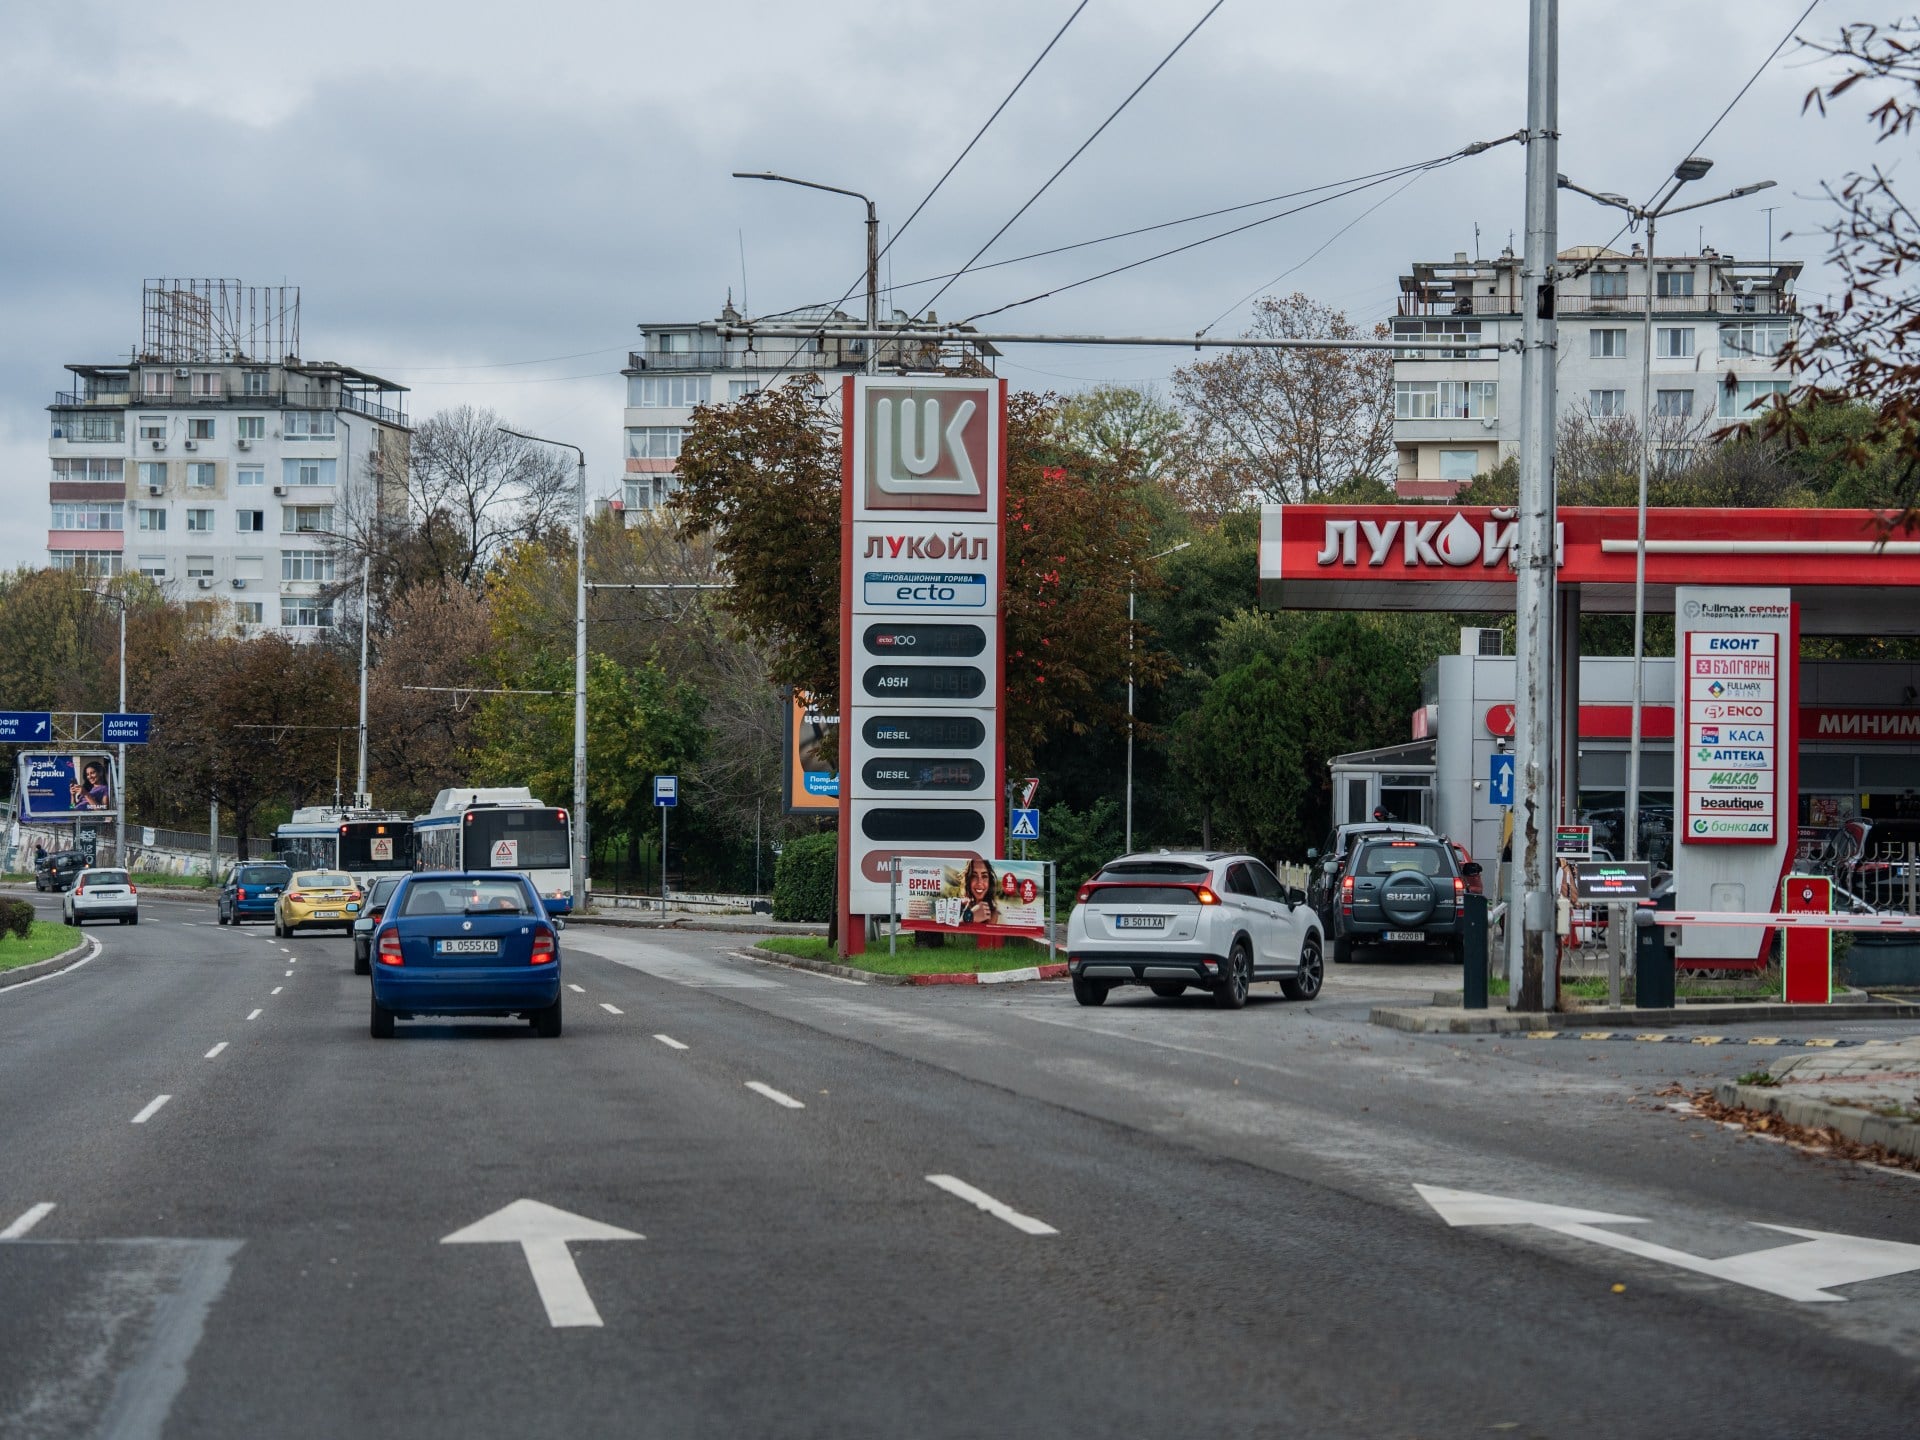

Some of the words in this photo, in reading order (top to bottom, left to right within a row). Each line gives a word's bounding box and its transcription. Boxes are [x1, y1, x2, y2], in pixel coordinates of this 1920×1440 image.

[1318, 507, 1564, 567] ЛУКОЙ
[864, 531, 988, 560] ЛУКОЙЛ
[882, 574, 941, 582] ИНОВАЦИОННИ
[944, 574, 973, 583] ГОРИВА
[896, 584, 955, 600] ecto
[1702, 604, 1746, 613] fullmax
[1750, 605, 1788, 614] center
[1710, 638, 1760, 650] ЕКОНТ
[878, 677, 908, 687] A95H
[1728, 706, 1762, 716] ENCO
[1729, 730, 1764, 741] КАСА
[1714, 750, 1764, 760] АПТЕКА
[1708, 772, 1759, 785] МАКАО
[1701, 797, 1764, 811] beautique
[909, 879, 940, 890] ВРЕМЕ
